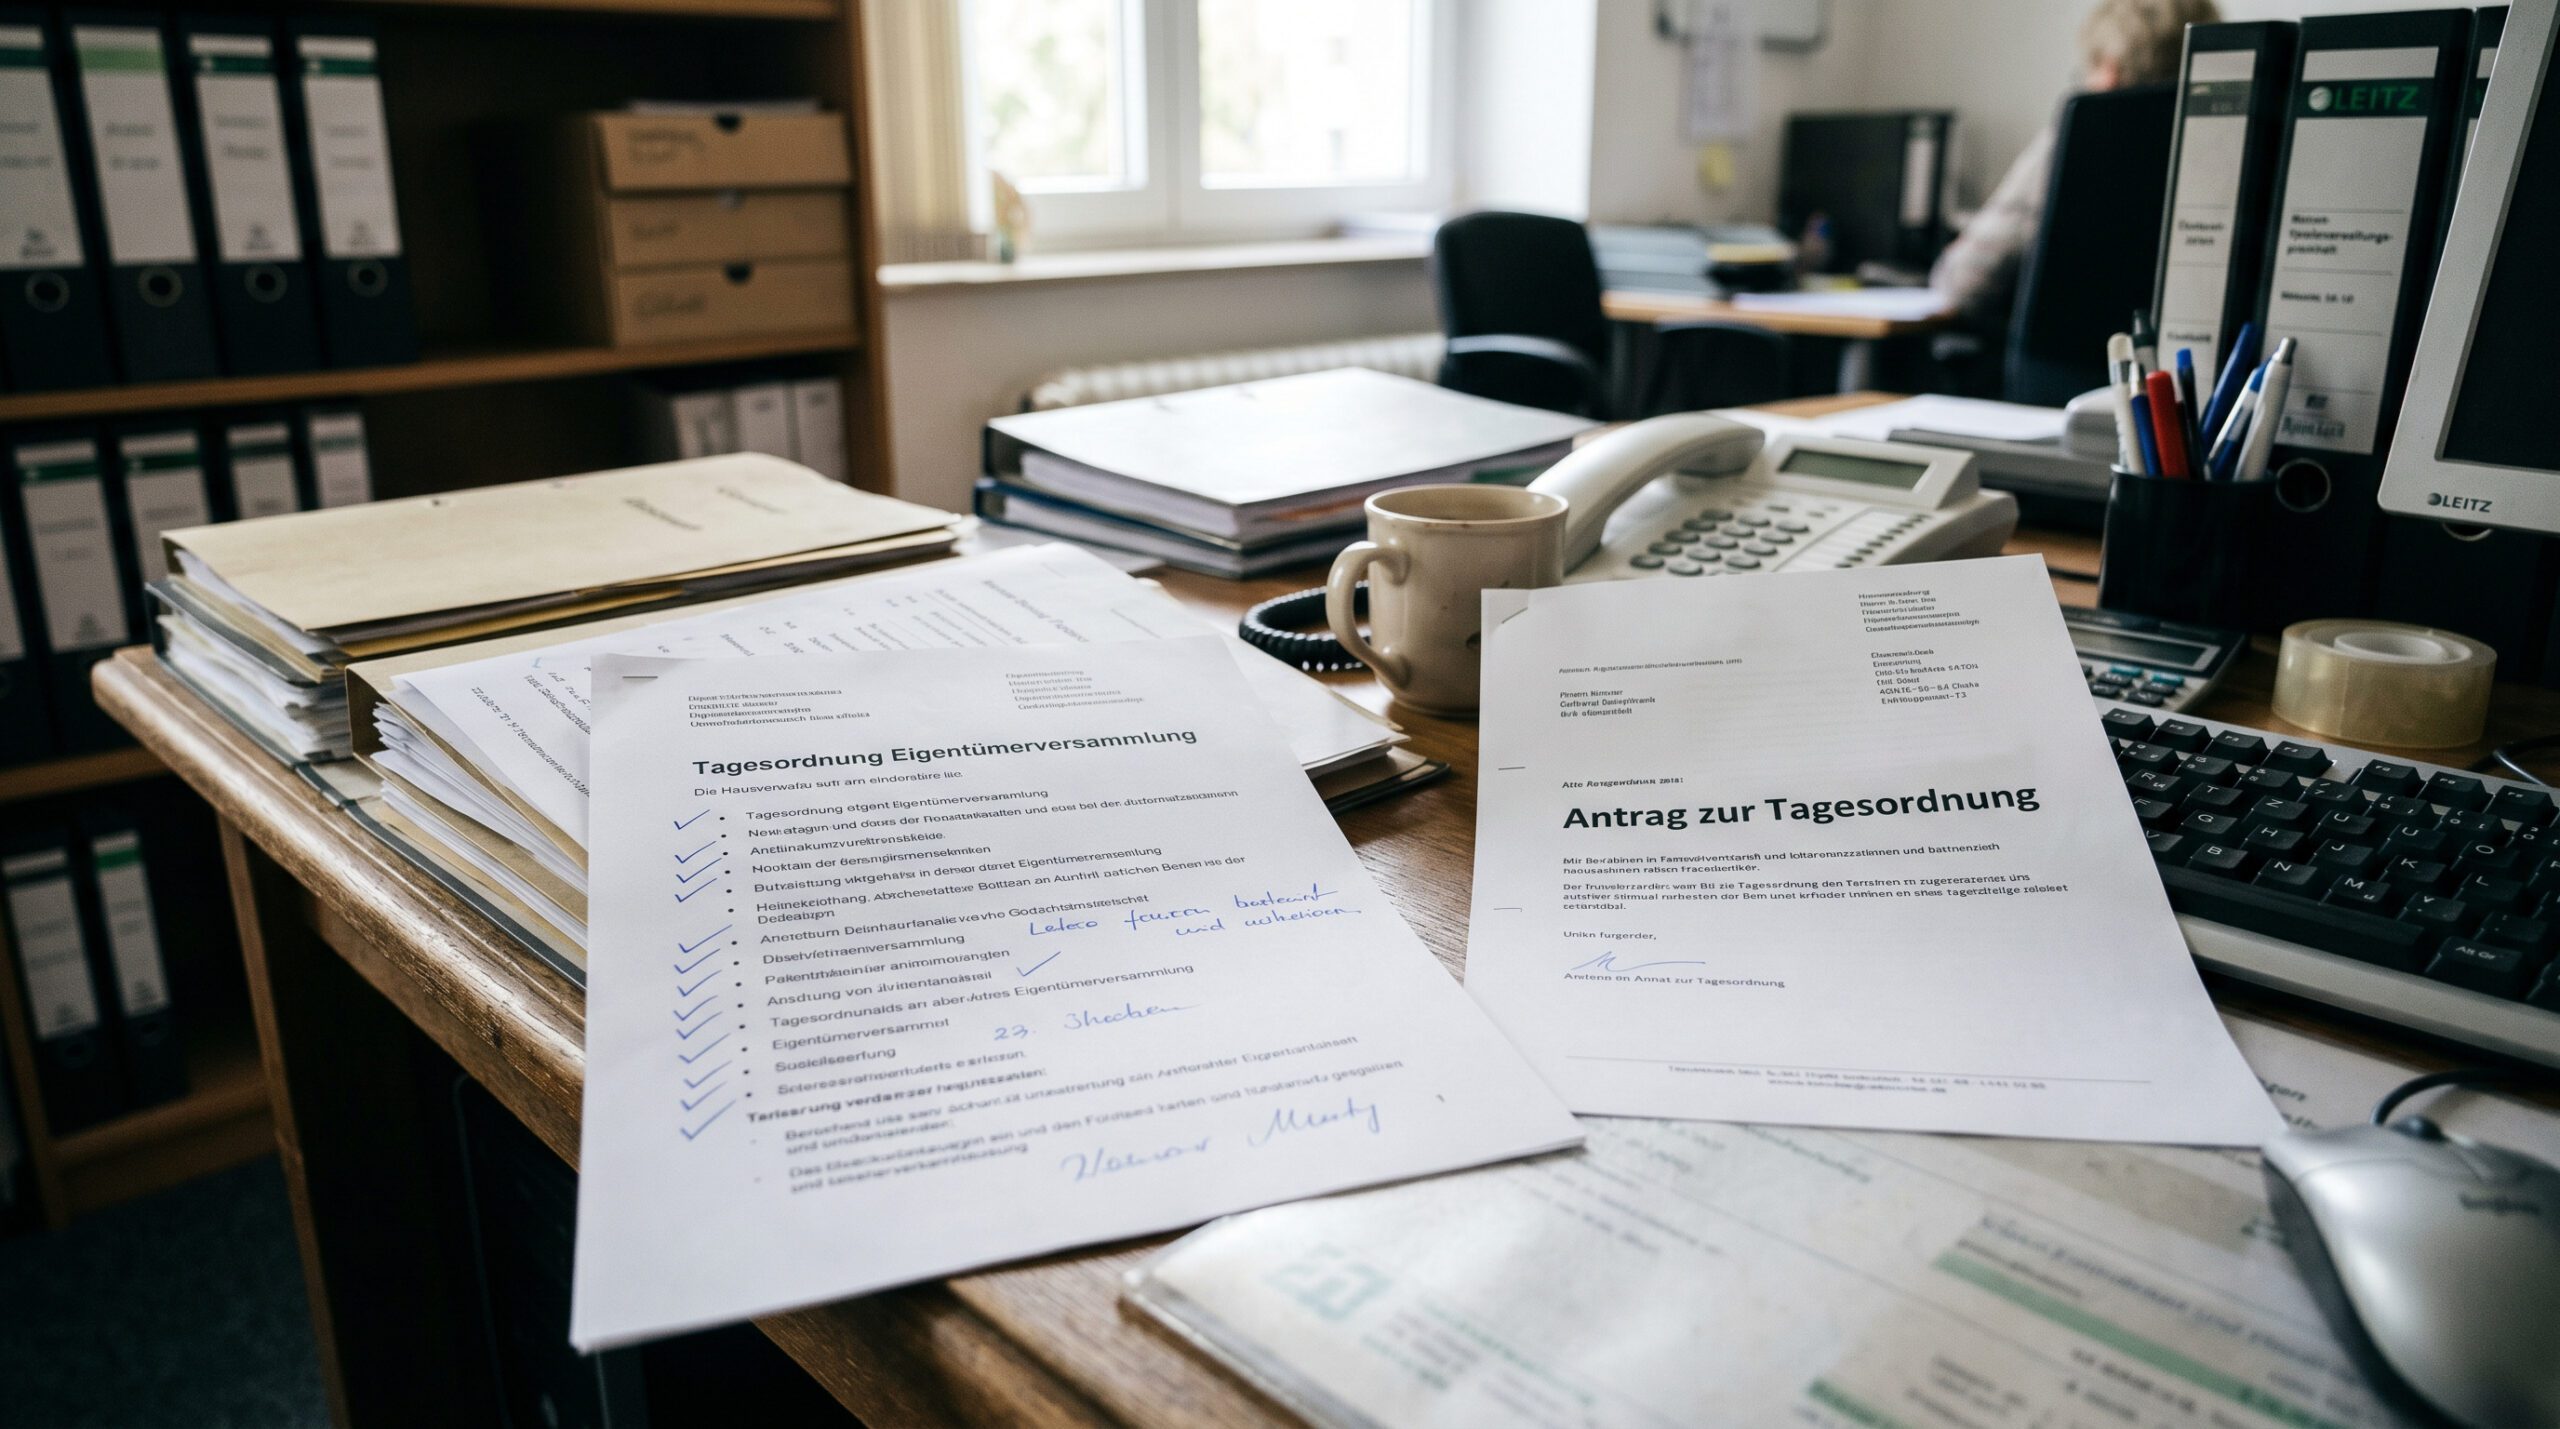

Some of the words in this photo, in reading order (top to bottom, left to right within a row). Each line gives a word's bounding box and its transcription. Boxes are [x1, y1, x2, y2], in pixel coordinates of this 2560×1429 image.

[2333, 85, 2420, 112] LEITZ
[2442, 495, 2493, 514] LEITZ
[692, 752, 884, 776] Tagesordnung
[890, 728, 1198, 765] Eigentümerversammlung
[694, 787, 717, 797] Die
[2207, 785, 2219, 794] T
[2134, 798, 2151, 806] F
[2265, 798, 2284, 809] Z
[745, 806, 843, 821] Tagesordnung
[1563, 807, 1688, 831] Antrag
[1699, 802, 1756, 824] zur
[1764, 786, 2040, 825] Tagesordnung
[831, 820, 858, 831] und
[1024, 805, 1049, 815] und
[2197, 813, 2215, 824] G
[2333, 812, 2350, 823] U
[2260, 826, 2279, 838] H
[2207, 845, 2223, 856] B
[2330, 843, 2346, 851] J
[1764, 852, 1787, 861] und
[1902, 846, 1925, 855] und
[815, 859, 836, 869] der
[2273, 860, 2293, 873] N
[2400, 858, 2419, 869] K
[919, 869, 931, 878] in
[2344, 877, 2364, 890] M
[2475, 875, 2489, 887] L
[1013, 965, 1195, 997] Eigentümerversammlung
[1696, 977, 1786, 989] Tagesordnung
[844, 986, 873, 997] von
